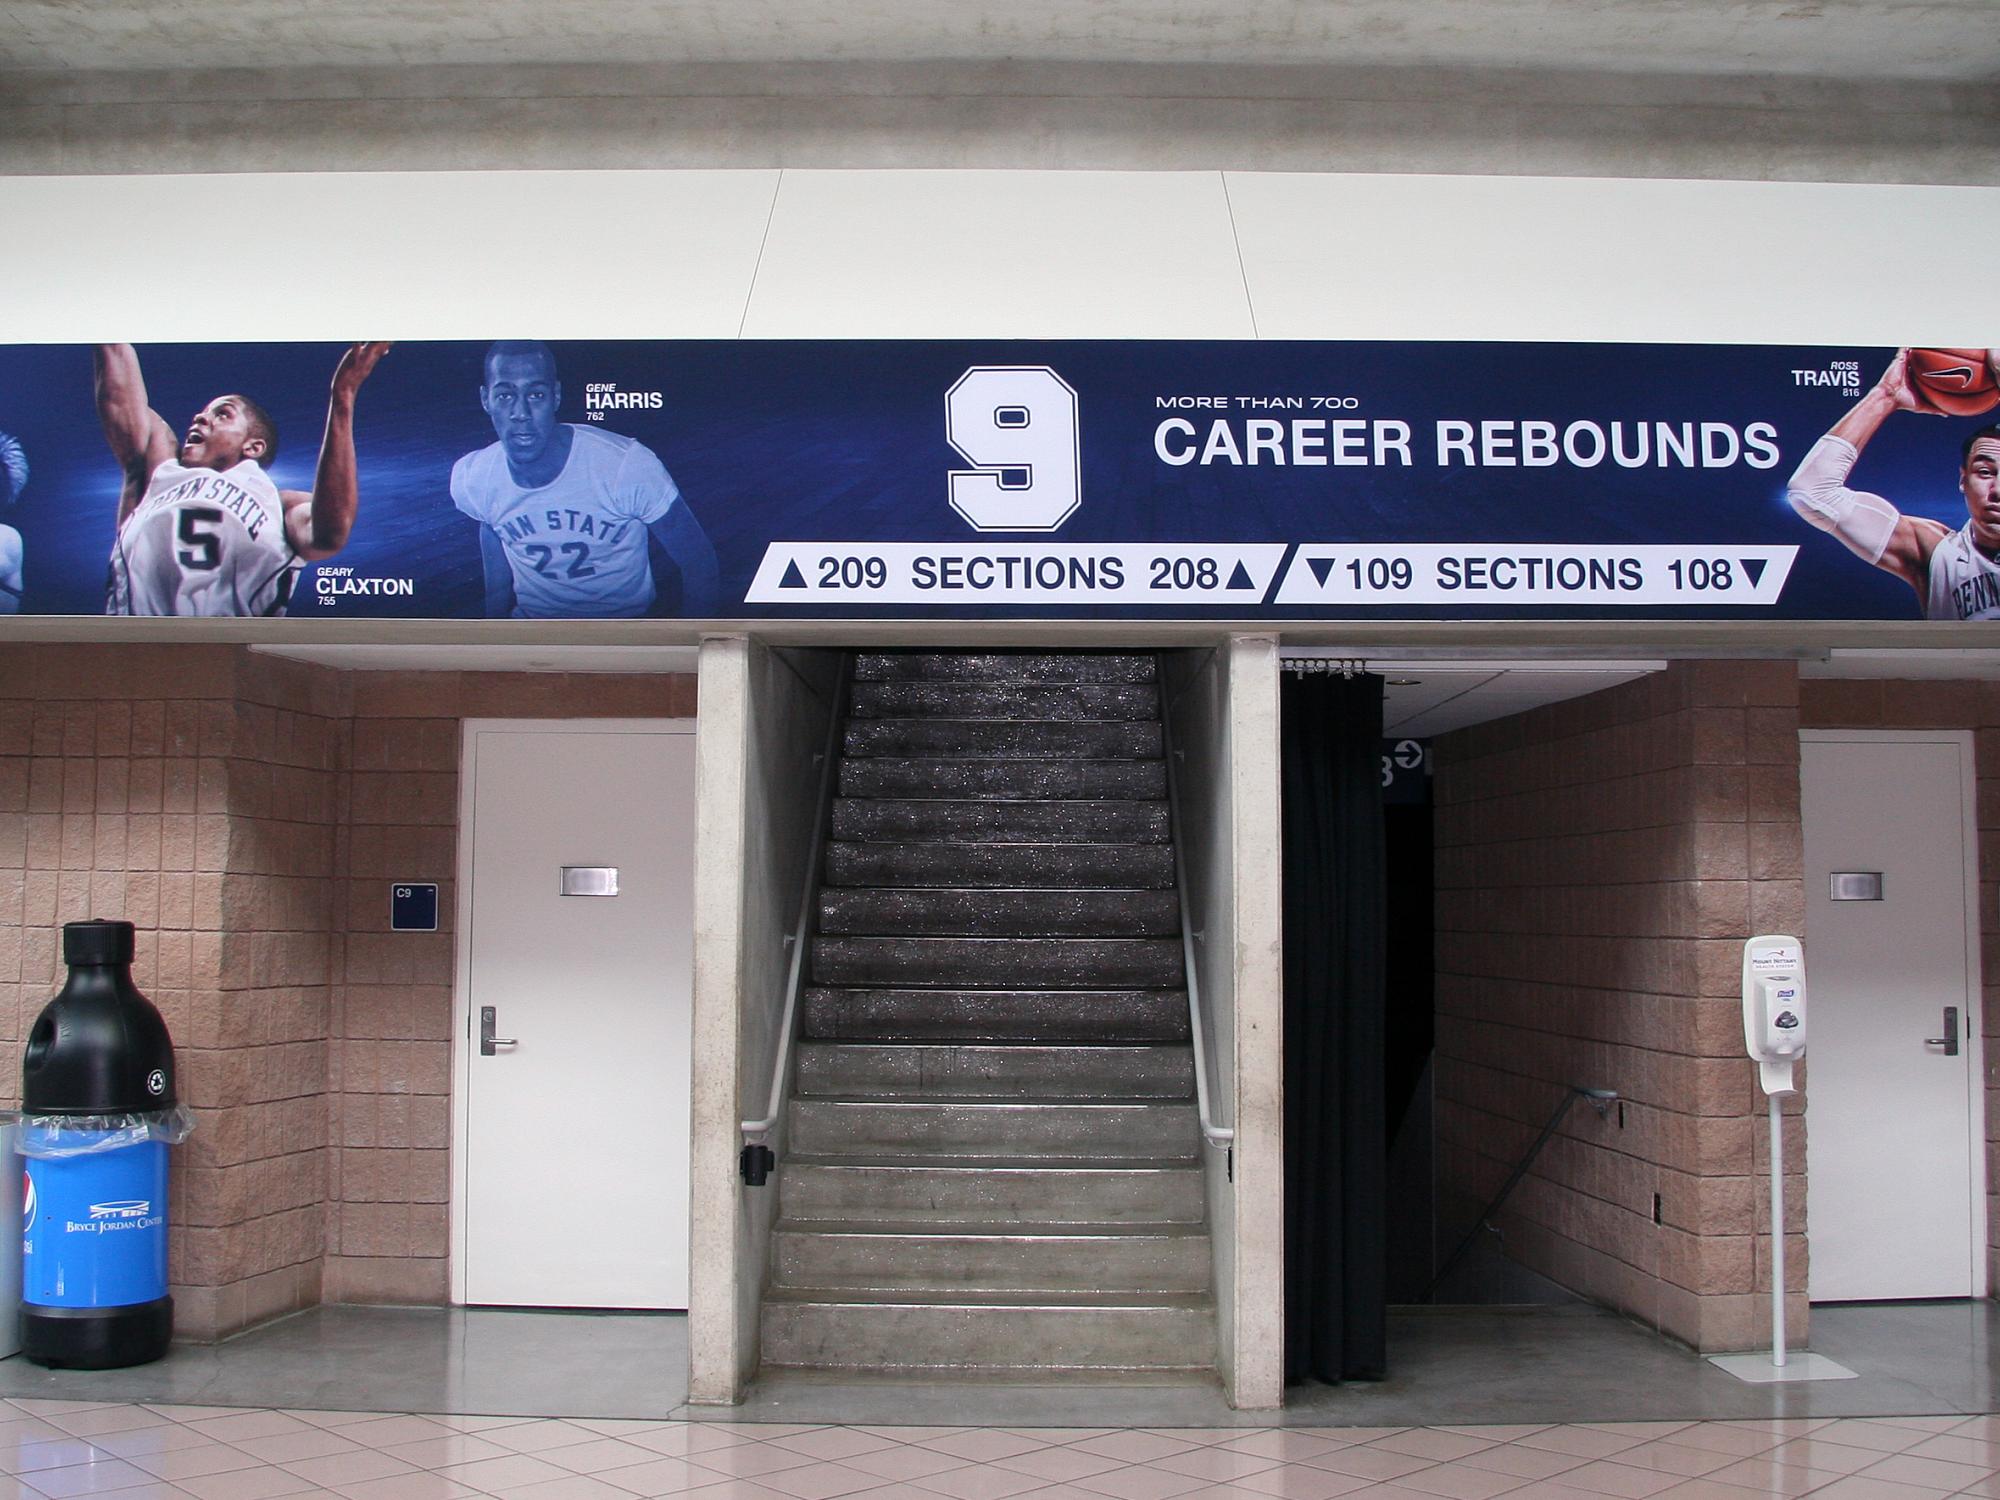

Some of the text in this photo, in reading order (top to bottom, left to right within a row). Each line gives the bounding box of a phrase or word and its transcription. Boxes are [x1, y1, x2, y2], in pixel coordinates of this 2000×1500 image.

[1830, 361, 1859, 370] ROSS
[1790, 369, 1861, 387] TRAVIS
[585, 383, 617, 393] GENE
[1842, 387, 1860, 397] 816
[585, 392, 664, 410] HARRIS
[1156, 396, 1359, 409] MORE THAN 700
[585, 411, 605, 421] 762
[944, 365, 1082, 533] 9
[1154, 417, 1780, 470] CAREER REBOUNDS
[205, 478, 269, 542] STATE
[178, 508, 223, 571] 5
[525, 541, 596, 580] 22
[317, 567, 354, 577] GEARY
[818, 556, 1219, 590] 209 SECTIONS 208
[1346, 557, 1733, 591] 109 SECTIONS 108
[316, 577, 414, 596] CLAXTON
[318, 596, 336, 606] 755
[1952, 572, 2000, 620] PENN
[396, 887, 412, 898] C9
[66, 1220, 97, 1233] BRYCE
[98, 1220, 136, 1235] JORDAN
